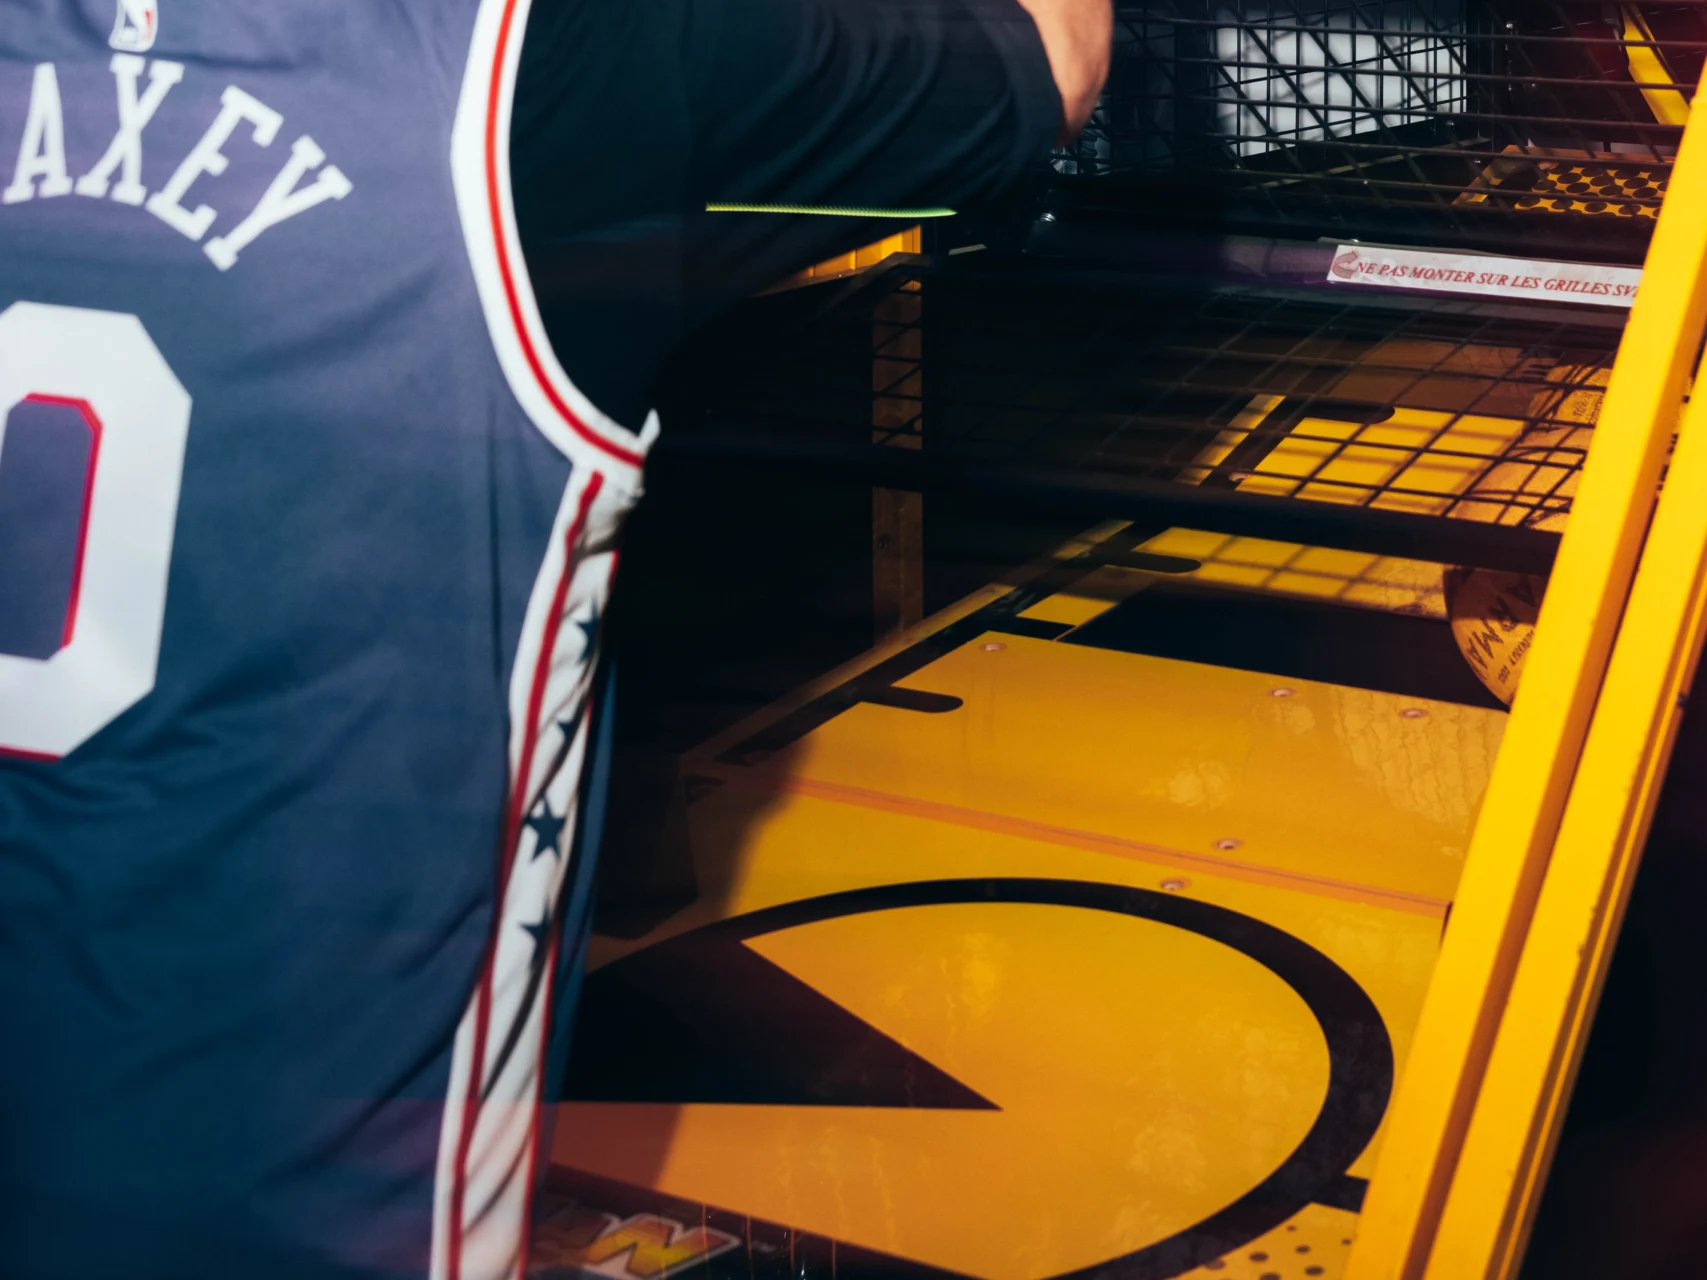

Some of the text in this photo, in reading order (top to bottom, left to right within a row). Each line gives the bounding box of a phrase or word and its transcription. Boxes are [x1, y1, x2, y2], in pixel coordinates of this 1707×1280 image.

[1358, 262, 1378, 275] NE
[1379, 264, 1409, 277] PAS
[1409, 267, 1476, 284] MONTER
[1477, 272, 1509, 287] SUR
[1510, 275, 1542, 289] LES
[1543, 278, 1612, 296] GRILLES
